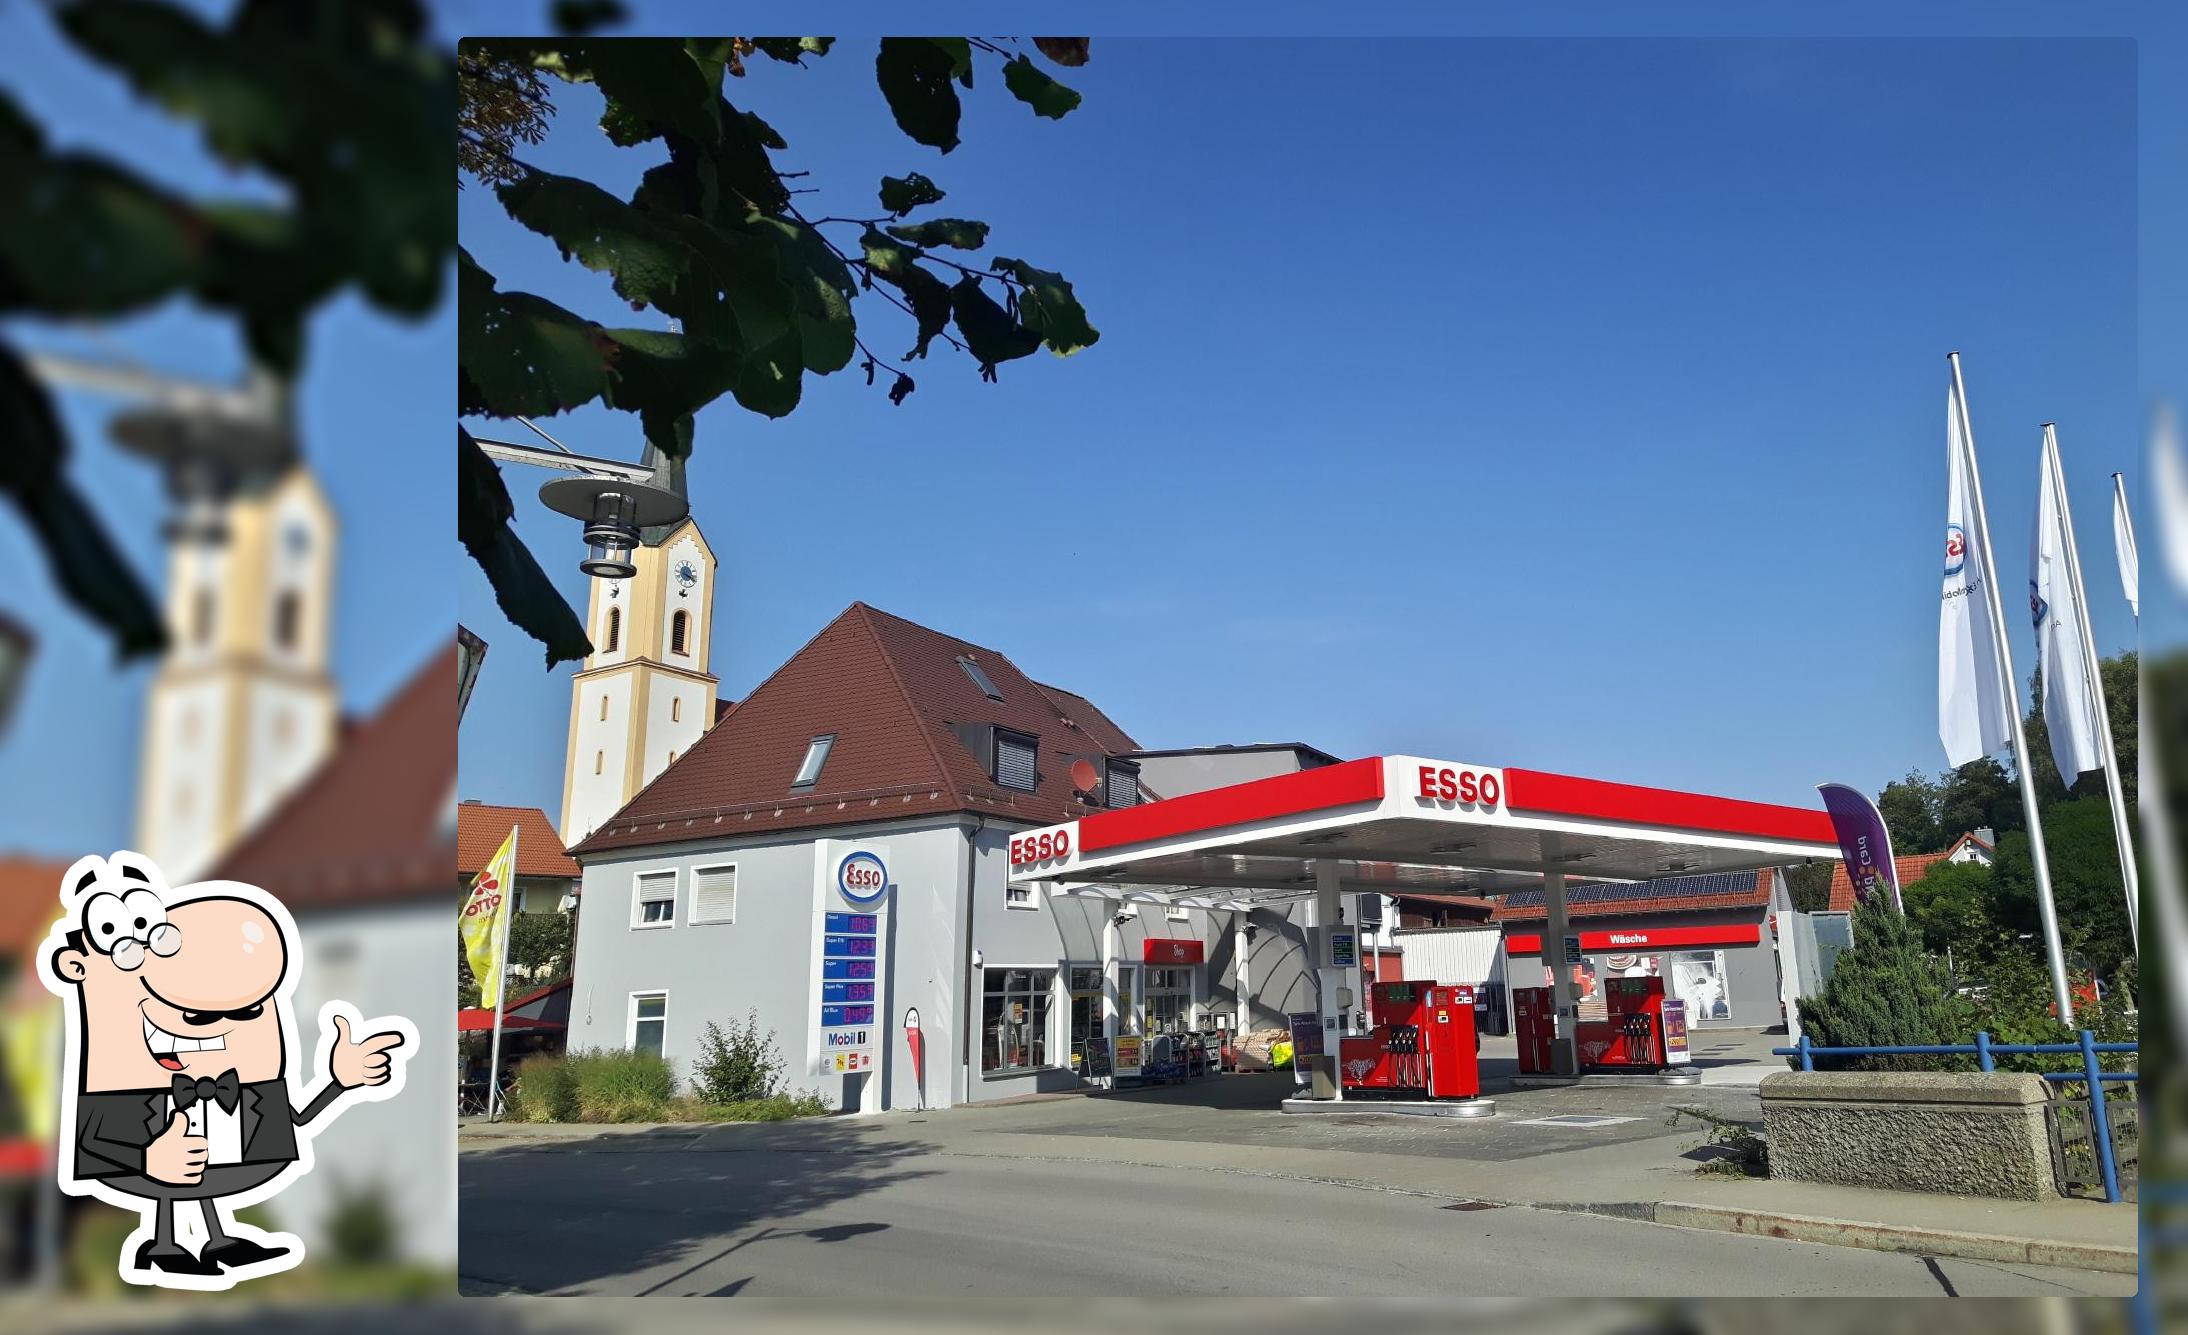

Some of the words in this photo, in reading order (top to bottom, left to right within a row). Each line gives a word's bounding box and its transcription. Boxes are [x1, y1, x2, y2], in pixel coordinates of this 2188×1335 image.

[1419, 766, 1500, 806] ESSO
[1011, 829, 1070, 865] ESSO
[846, 863, 881, 887] Esso
[1610, 933, 1648, 945] Wäsche
[828, 1032, 856, 1046] Mobil
